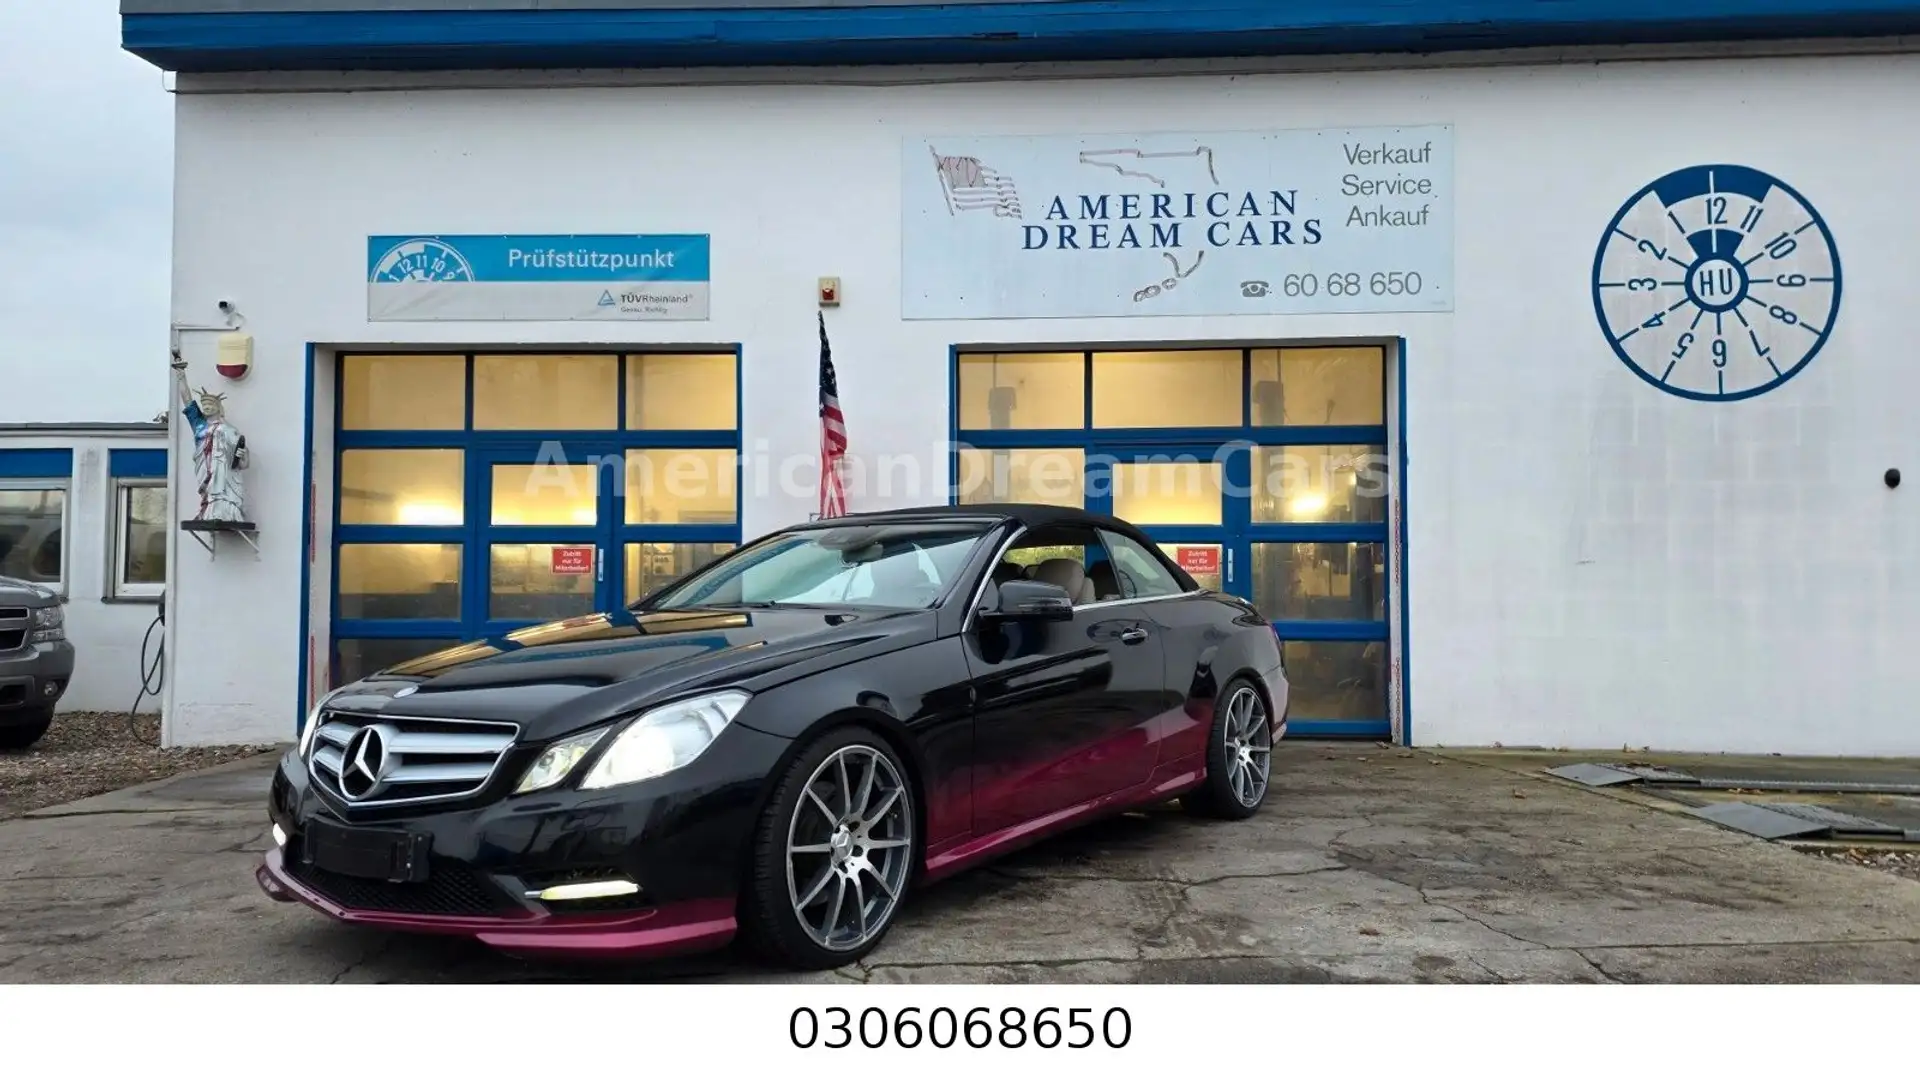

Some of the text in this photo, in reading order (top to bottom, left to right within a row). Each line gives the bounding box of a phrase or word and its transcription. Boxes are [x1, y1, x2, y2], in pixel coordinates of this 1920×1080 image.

[1343, 142, 1433, 166] Verkauf
[1341, 174, 1433, 197] Service
[1045, 189, 1299, 220] AMERICAN
[1345, 205, 1430, 229] Ankauf
[1705, 196, 1728, 225] 12
[1740, 205, 1764, 233] 11
[1021, 218, 1323, 250] DREAM CARS
[1764, 231, 1798, 260] 10
[508, 248, 675, 273] Prüfstützpunkt
[1637, 238, 1668, 261] 2
[1282, 271, 1422, 298] 60 68 650
[1627, 277, 1658, 292] 3
[1699, 267, 1733, 297] HU
[1776, 273, 1807, 288] 9
[1640, 310, 1667, 329] 4
[1768, 304, 1798, 326] 8
[1671, 331, 1695, 360] 5
